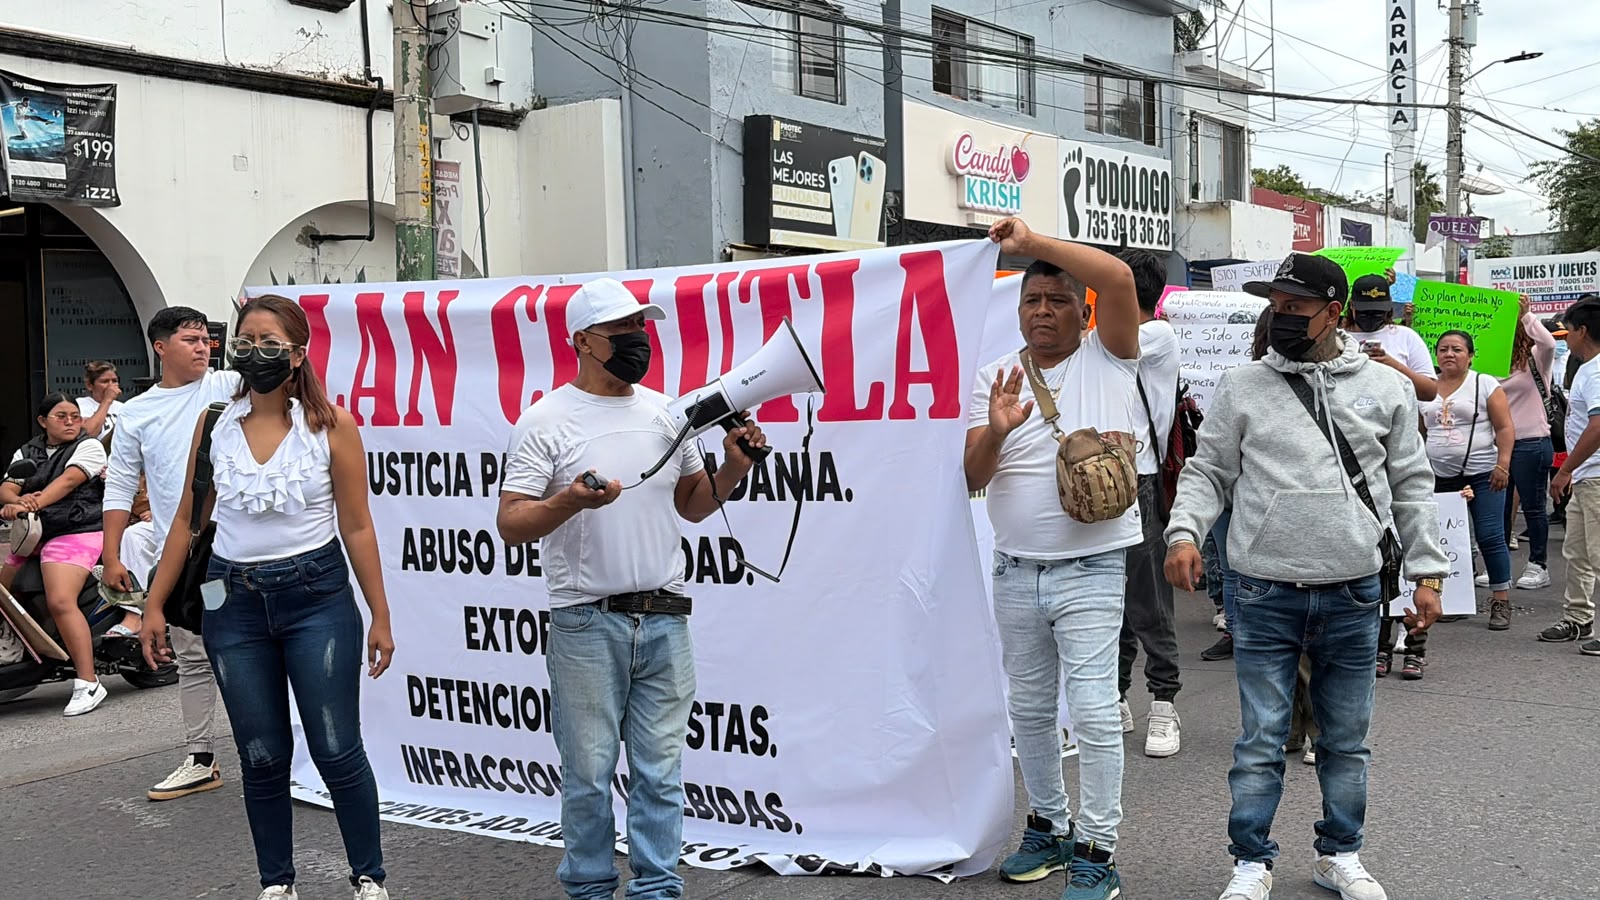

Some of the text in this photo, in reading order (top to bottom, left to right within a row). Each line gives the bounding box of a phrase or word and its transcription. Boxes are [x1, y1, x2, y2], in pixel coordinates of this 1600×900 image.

[1389, 0, 1409, 125] ARMACIA
[780, 122, 803, 134] PROTEC
[73, 138, 114, 161] $199
[773, 148, 794, 165] LAS
[954, 133, 1012, 183] Candy
[772, 166, 826, 189] MEJORES
[1085, 156, 1171, 215] PODÓLOGO
[966, 177, 1021, 210] KRISH
[1085, 208, 1109, 241] 735
[1130, 215, 1137, 243] 8
[1139, 215, 1155, 245] 36
[1156, 218, 1170, 246] 28
[1428, 220, 1480, 233] QUEEN
[1513, 261, 1597, 280] LUNES Y JUEVES
[1437, 289, 1457, 305] plan
[1558, 284, 1573, 292] DÍAS
[298, 290, 460, 427] LAN
[748, 369, 767, 383] Steren
[368, 451, 473, 497] USTICIA
[402, 527, 496, 575] ABUSO
[505, 537, 542, 577] DE
[686, 700, 777, 759] STAS.
